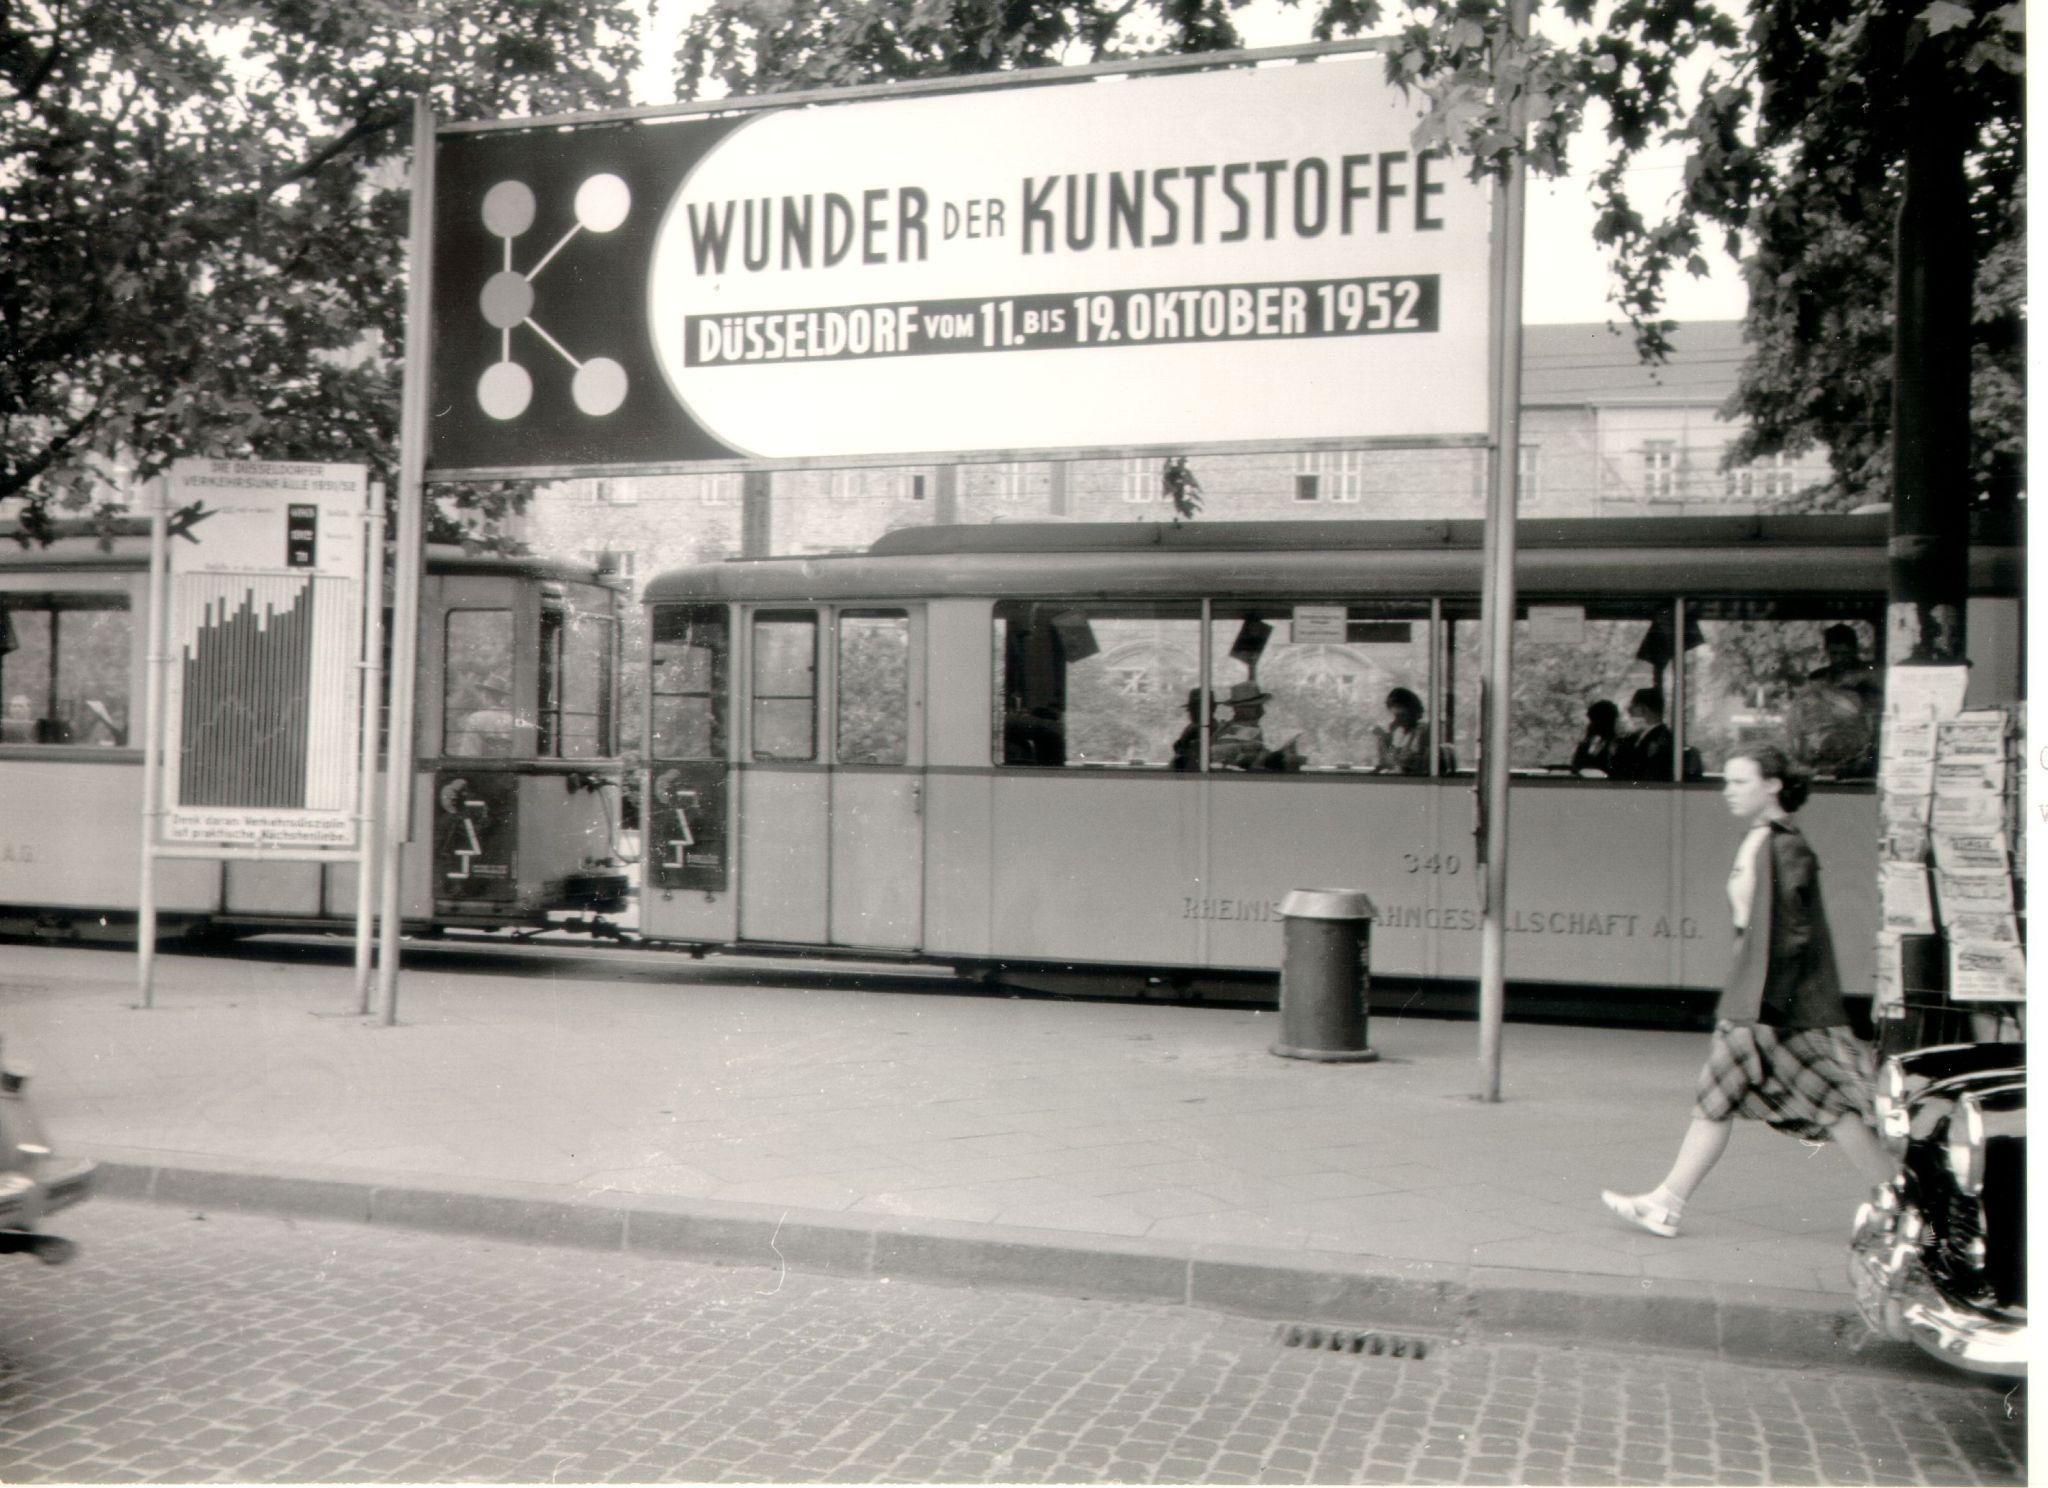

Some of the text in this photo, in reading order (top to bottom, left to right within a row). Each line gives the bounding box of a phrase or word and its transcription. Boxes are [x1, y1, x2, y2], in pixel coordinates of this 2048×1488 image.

[687, 148, 1445, 276] WUNDER DER KUNSTSTOFFE
[699, 306, 919, 362] DÜSSELDORF
[923, 314, 974, 348] VOM
[1022, 309, 1066, 335] BIS
[1127, 287, 1308, 340] OKTOBER
[1318, 280, 1421, 332] 1952
[1403, 853, 1461, 875] 340
